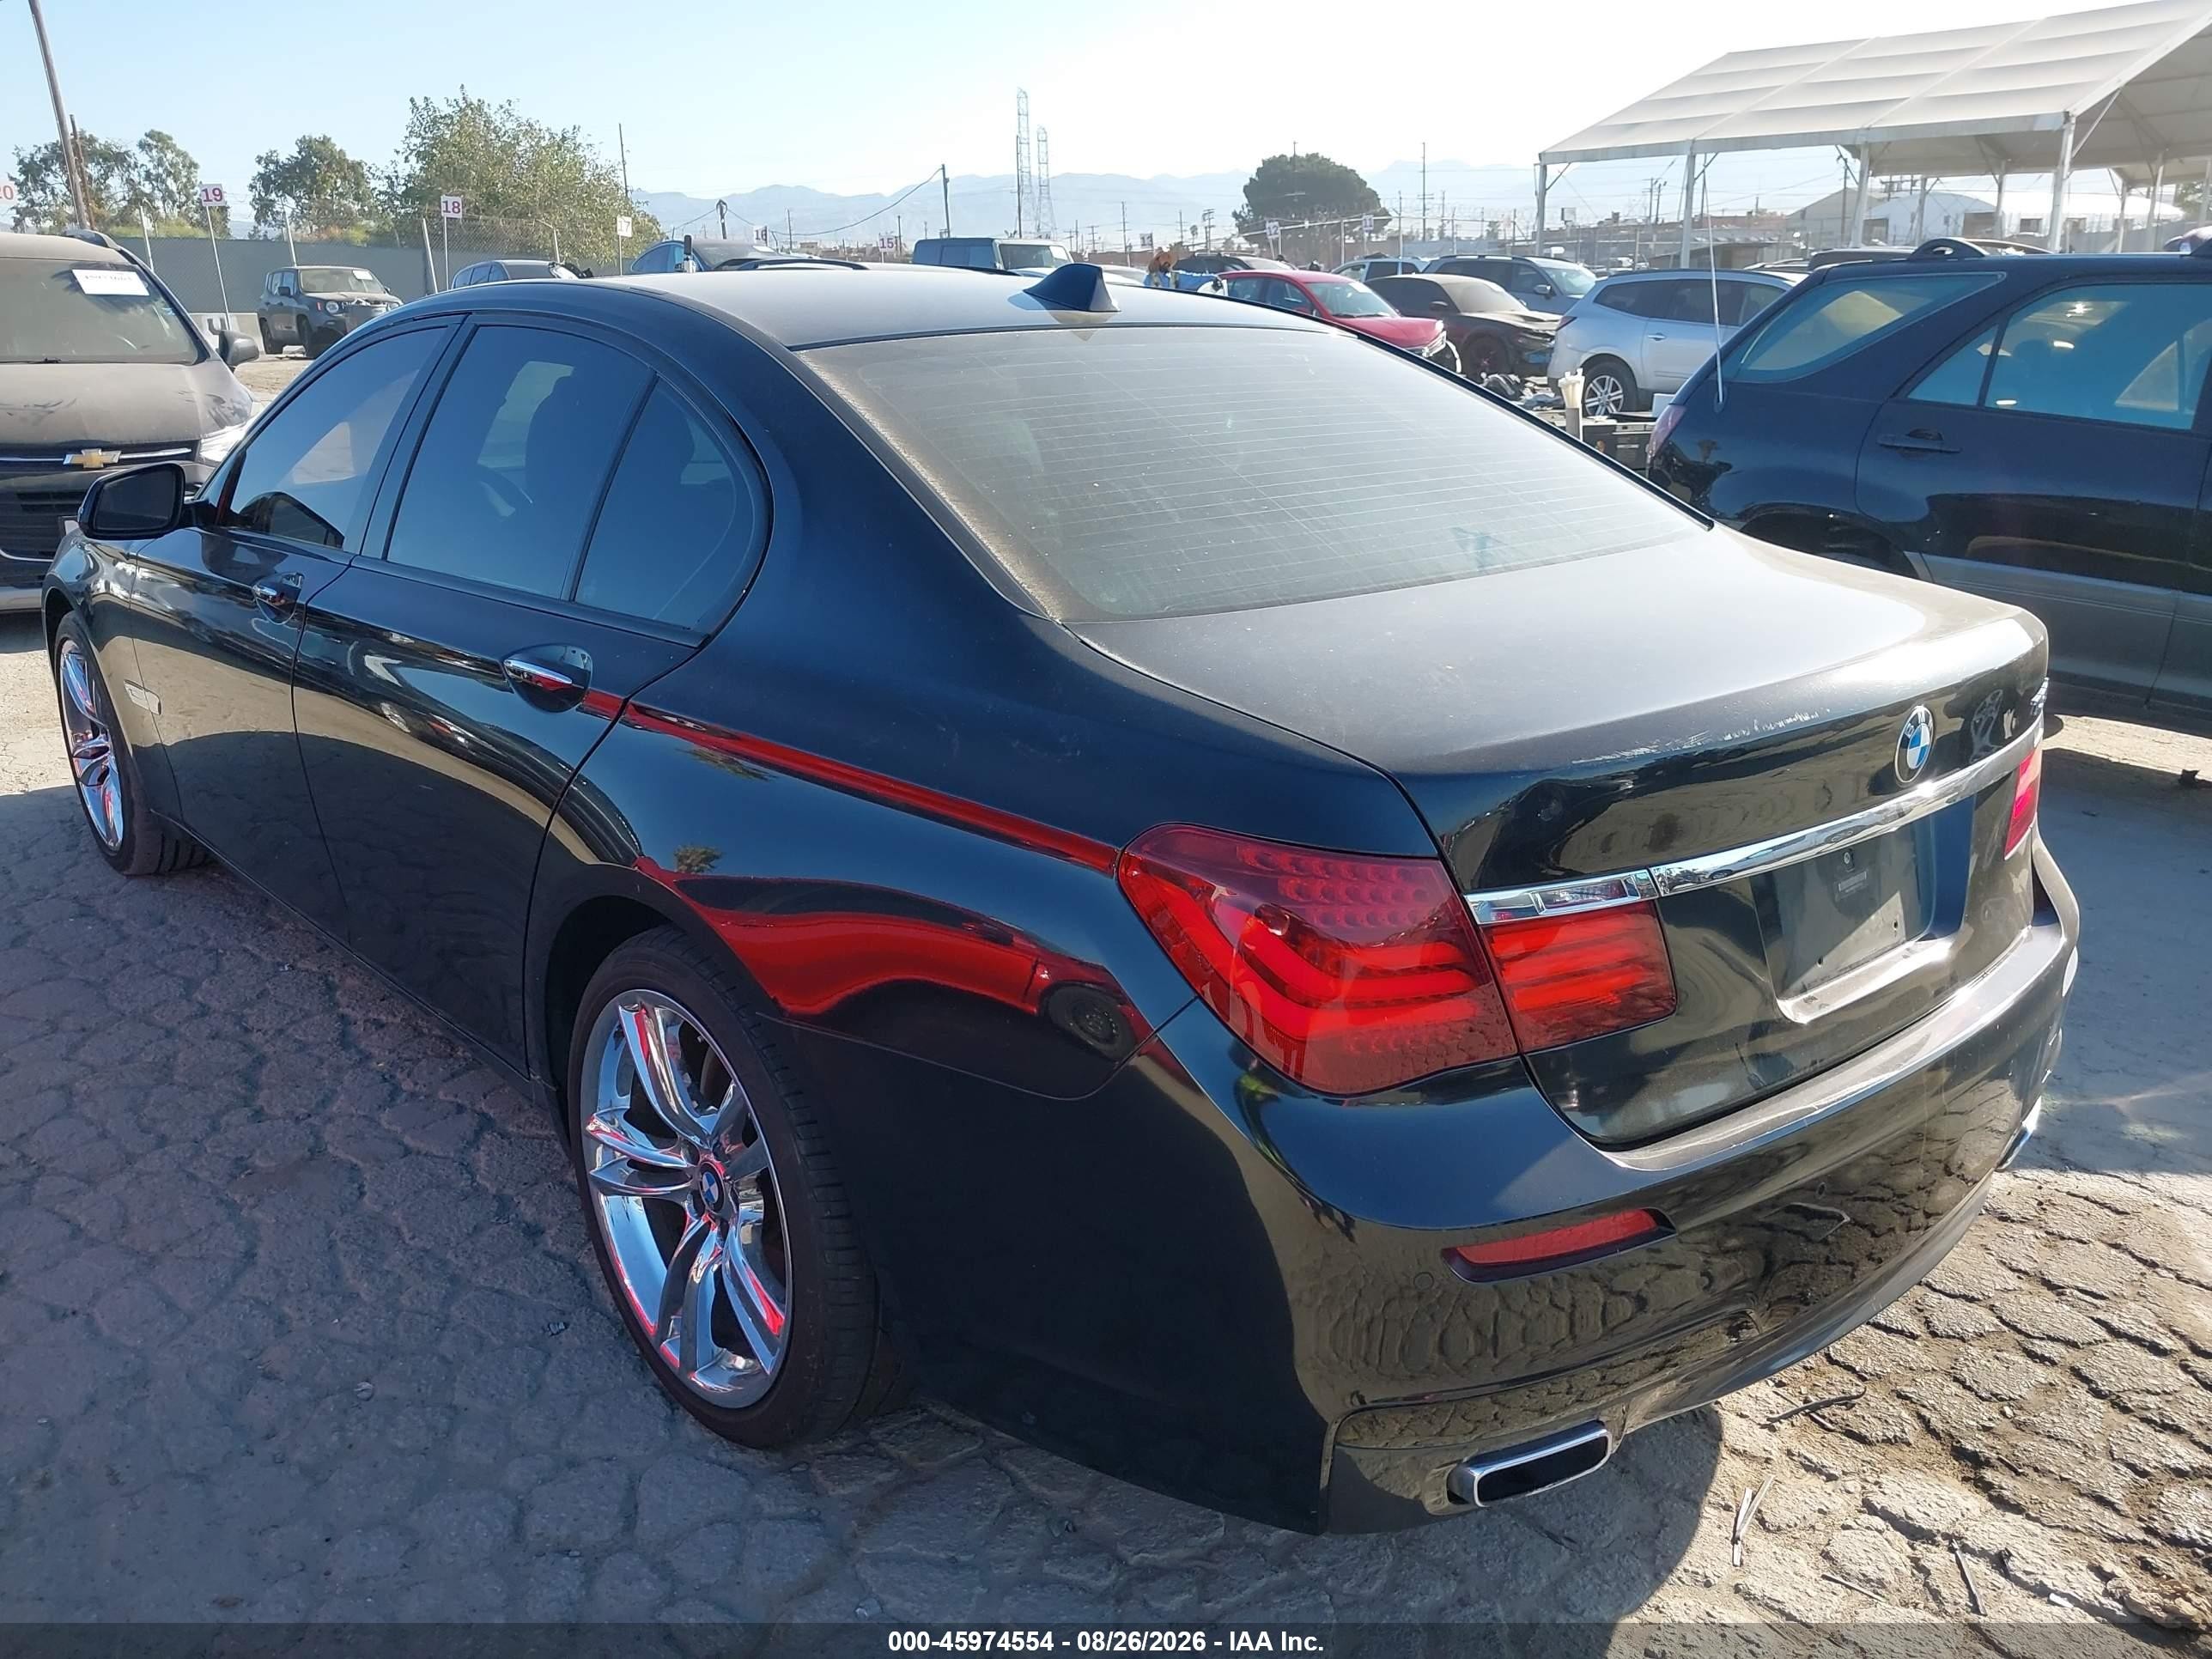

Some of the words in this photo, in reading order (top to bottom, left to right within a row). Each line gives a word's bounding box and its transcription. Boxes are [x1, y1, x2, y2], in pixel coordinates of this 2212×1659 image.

[0, 185, 14, 200] 0
[201, 187, 223, 202] 19
[442, 200, 460, 214] 18
[618, 220, 630, 232] 17
[879, 237, 894, 249] 15
